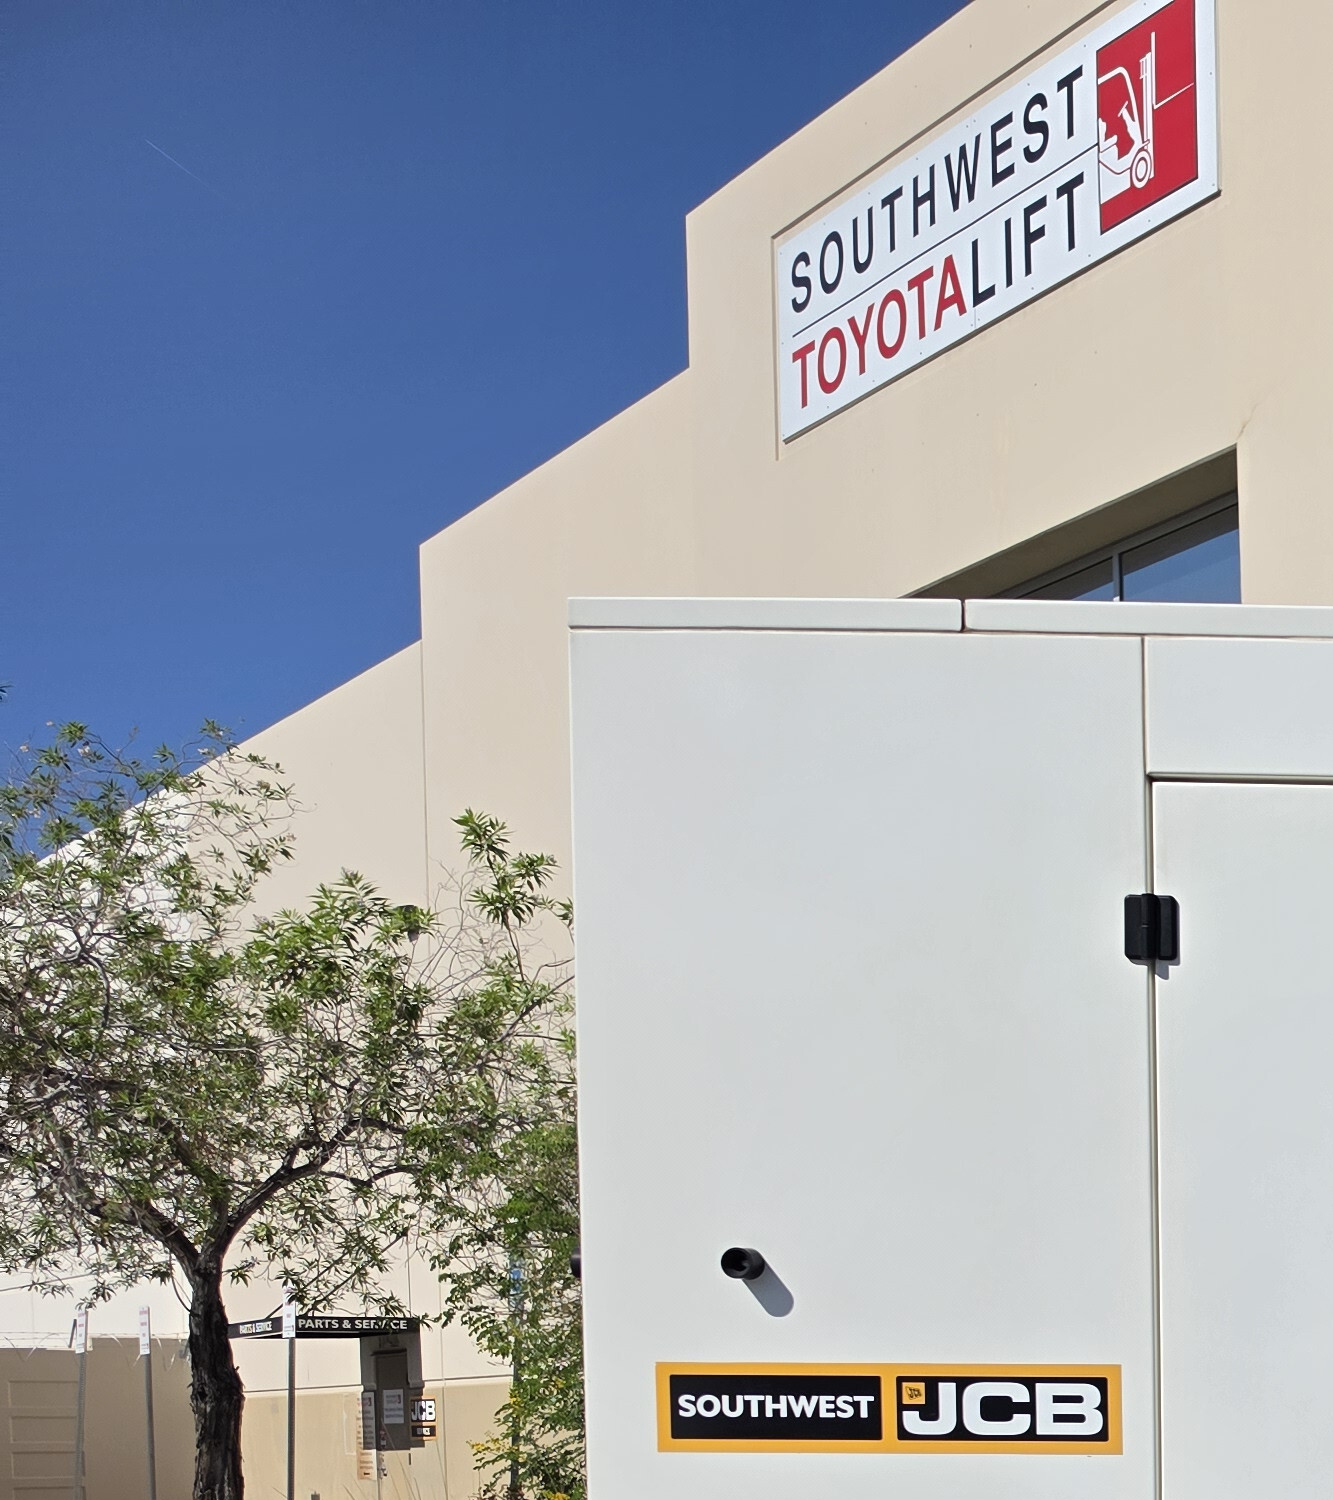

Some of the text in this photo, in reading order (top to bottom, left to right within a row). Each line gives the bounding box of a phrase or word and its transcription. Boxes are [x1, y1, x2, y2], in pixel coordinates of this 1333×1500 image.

[791, 65, 1084, 314] SOUTHWEST
[792, 172, 1084, 409] TOYOTALIFT
[298, 1319, 339, 1329] PARTS
[342, 1319, 351, 1329] &
[411, 1400, 436, 1421] JCB
[678, 1381, 1104, 1436] SOUTHWEST JCB
